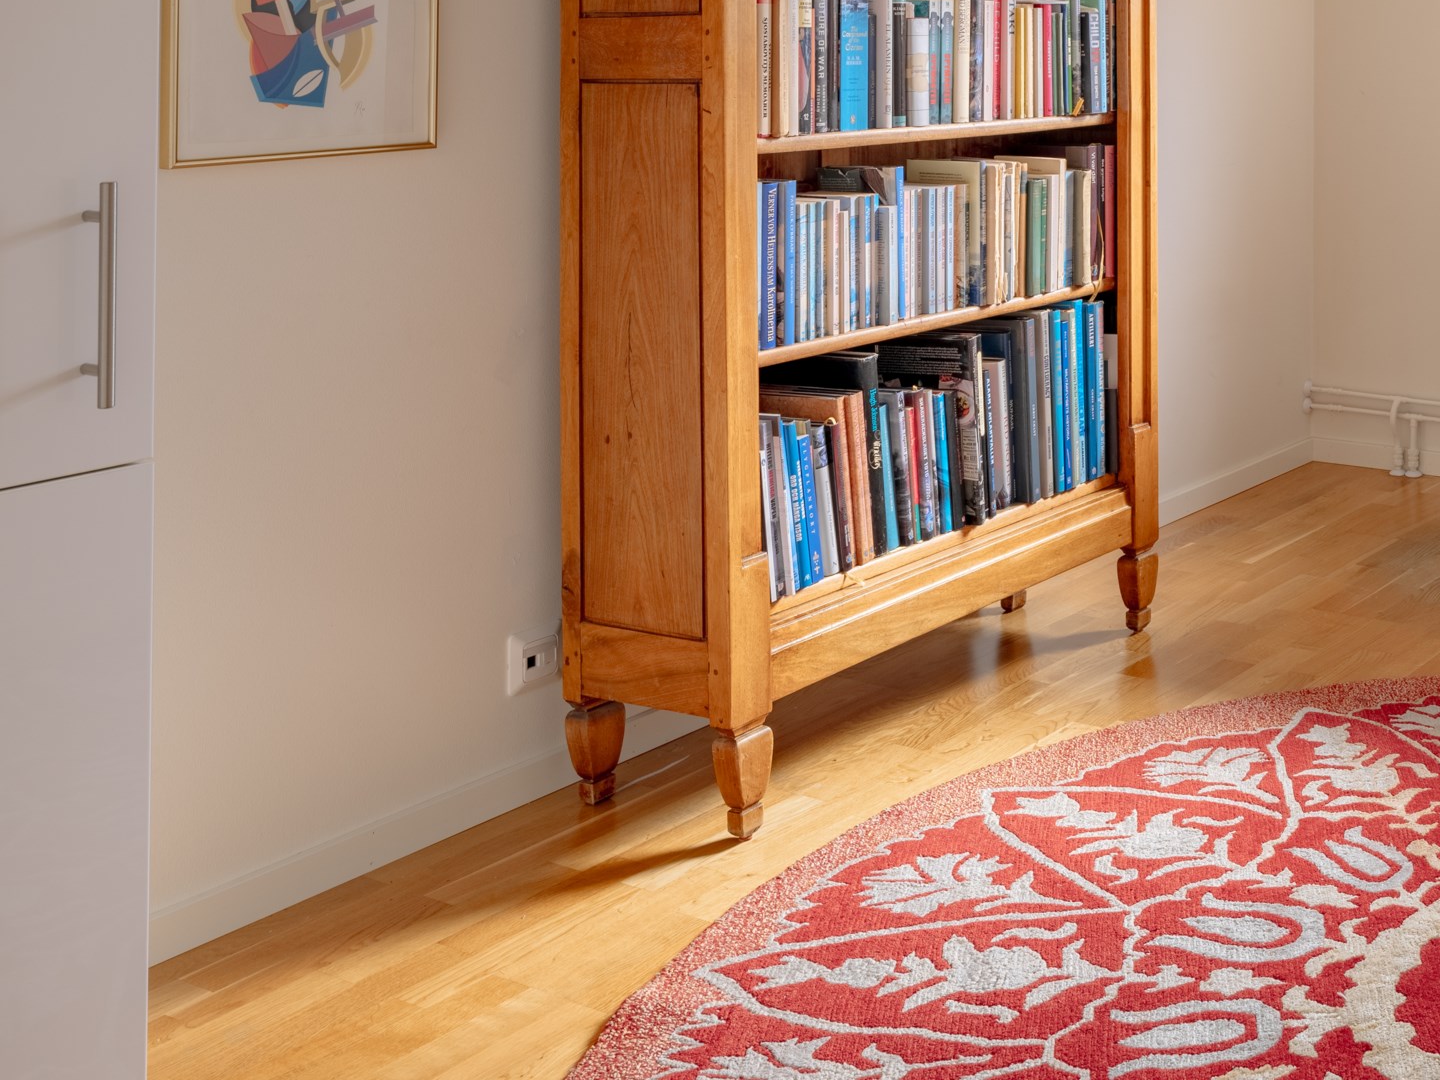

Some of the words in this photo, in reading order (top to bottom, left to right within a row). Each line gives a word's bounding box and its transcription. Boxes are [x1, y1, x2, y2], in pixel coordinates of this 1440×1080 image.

[1008, 0, 1016, 36] TAKI
[1090, 12, 1100, 48] CHILD
[818, 39, 826, 52] OF
[817, 55, 825, 79] WAR
[768, 187, 777, 217] VERNER
[767, 235, 776, 285] HEIDENSTAM
[767, 286, 776, 342] Karolinerna
[868, 387, 877, 407] Hugh
[789, 474, 797, 488] ORD
[791, 488, 799, 501] OCH
[770, 497, 778, 520] VAPEN
